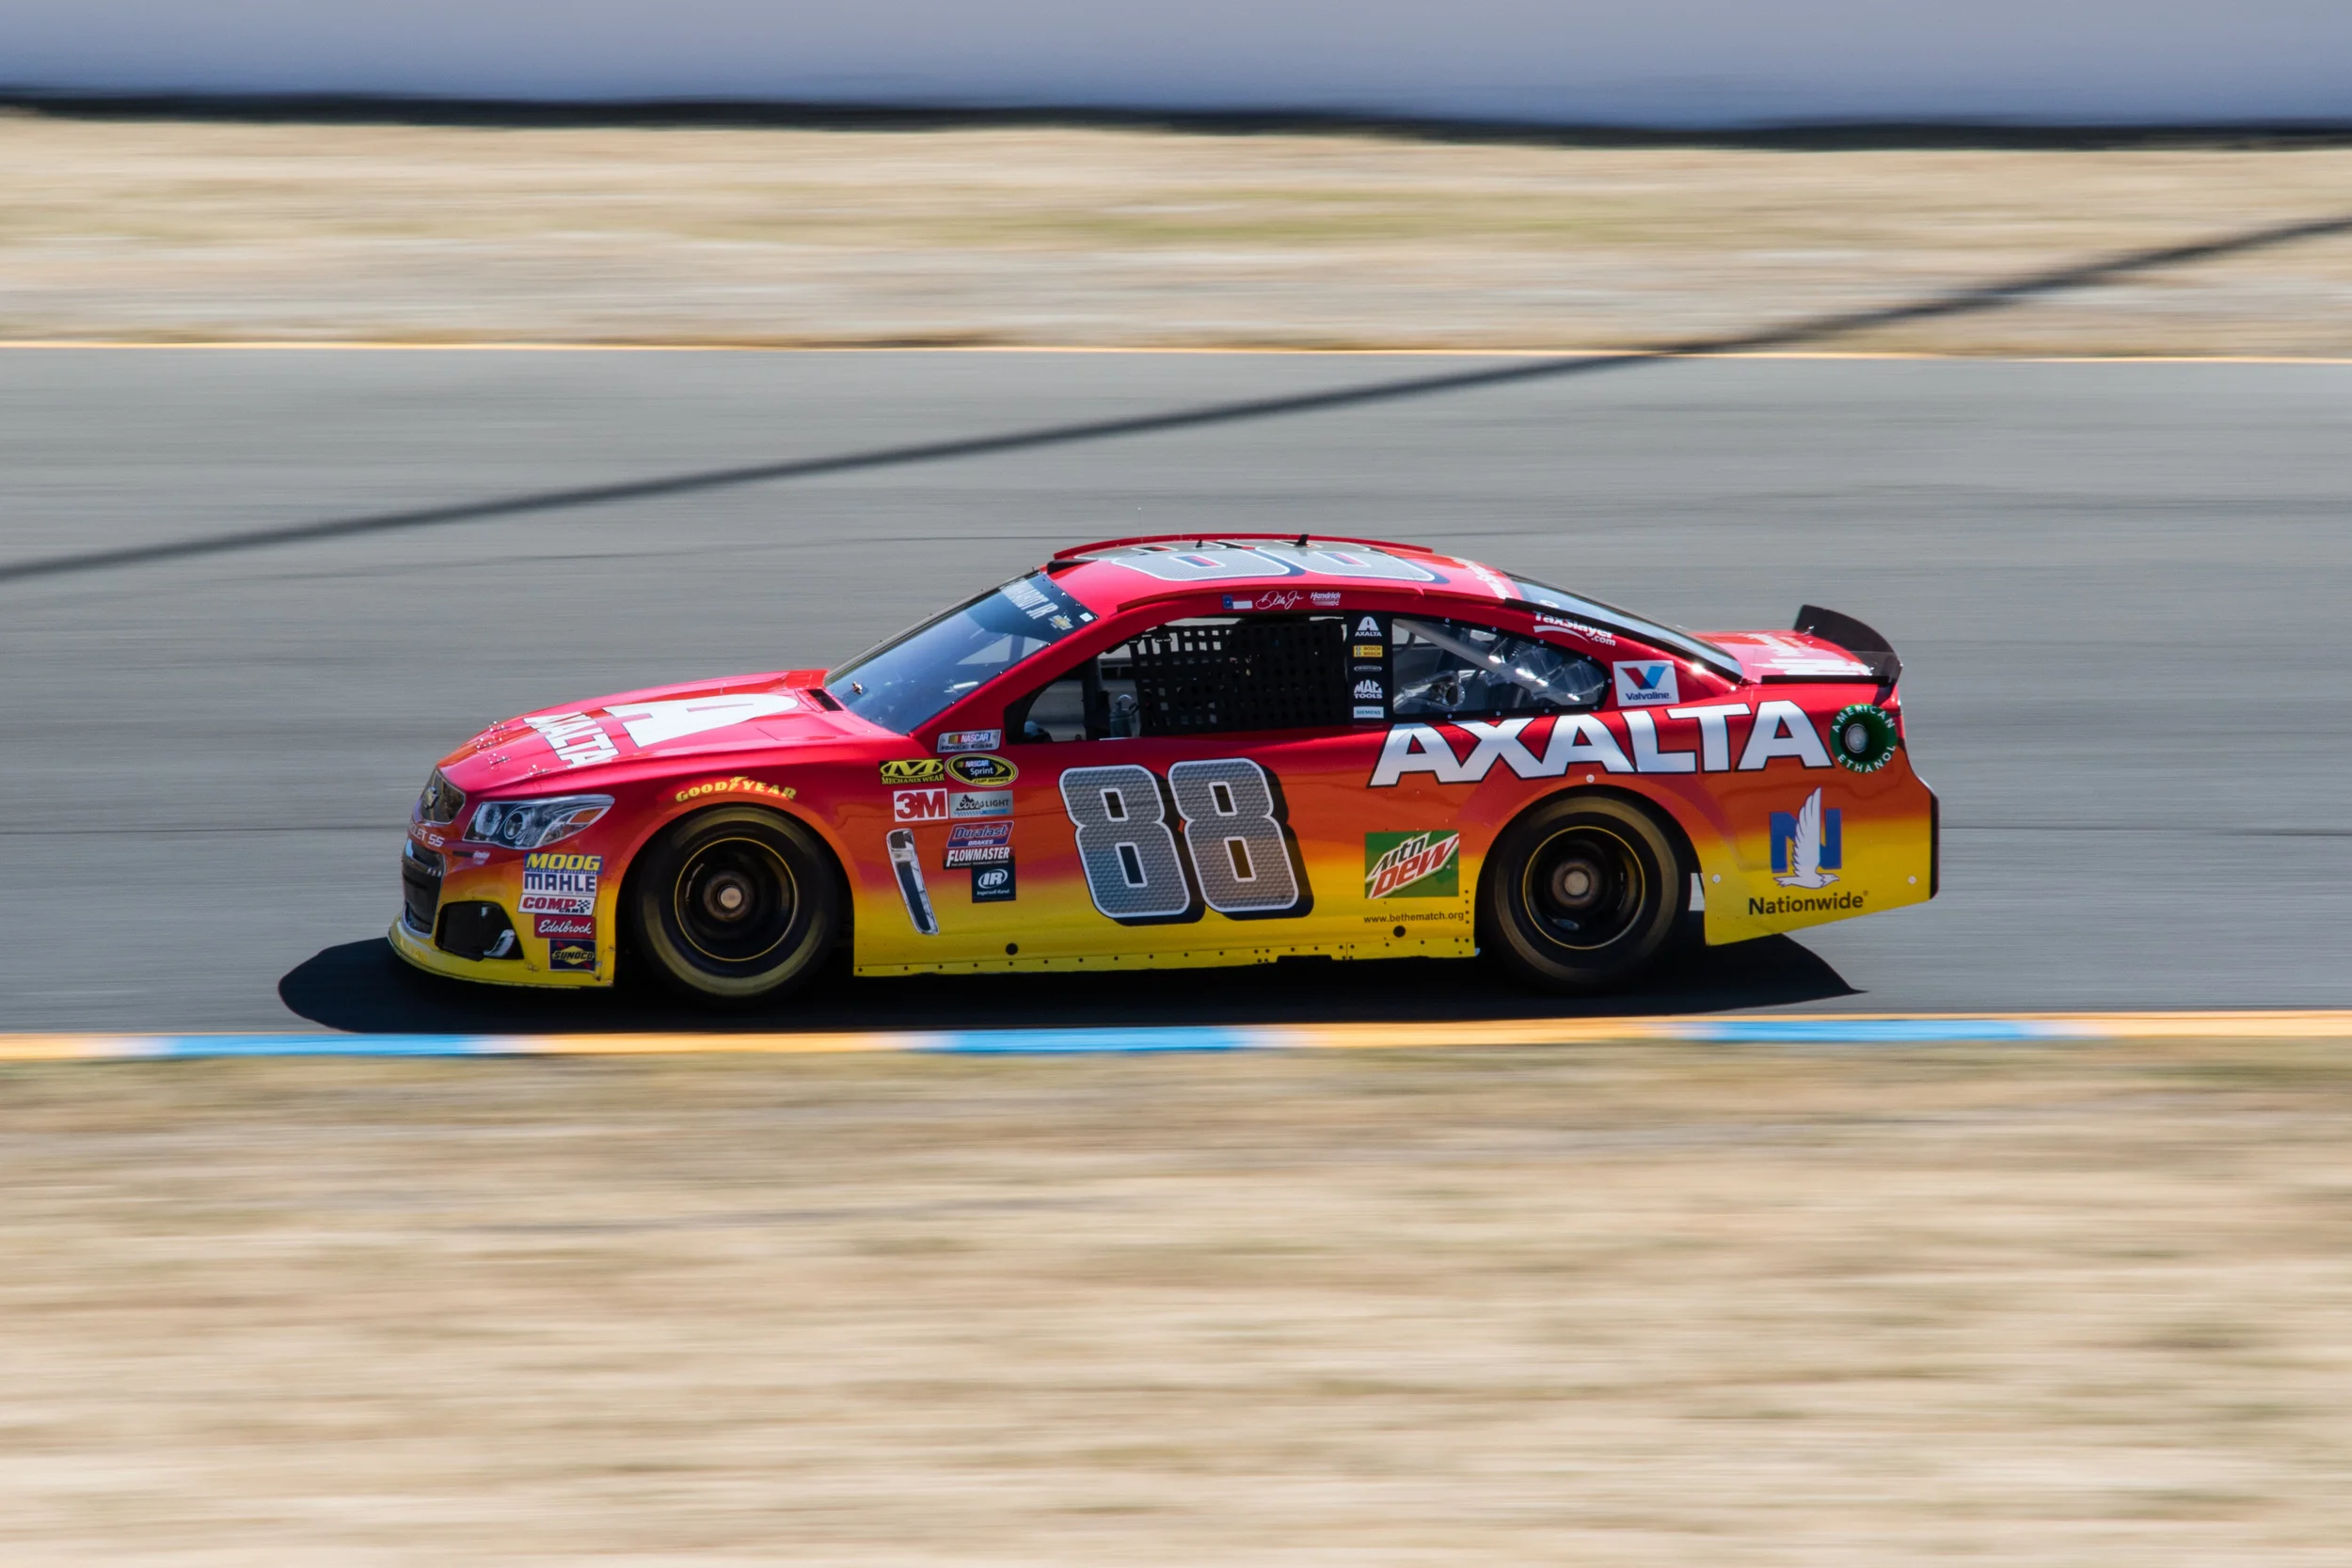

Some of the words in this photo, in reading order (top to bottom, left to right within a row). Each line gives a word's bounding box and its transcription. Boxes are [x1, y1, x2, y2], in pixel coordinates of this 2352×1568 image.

[1310, 592, 1341, 601] Hendrick
[1025, 602, 1058, 620] JR
[1533, 611, 1613, 639] TaxSlayer
[1591, 636, 1616, 646] .com
[1354, 679, 1383, 694] MAC
[1626, 691, 1670, 701] Valvoline
[1832, 705, 1895, 733] AMERICAN
[961, 733, 990, 743] NASCAR
[1369, 700, 1835, 788] AXALTA
[965, 759, 990, 768] NASCAR
[1837, 745, 1896, 773] ETHANOL
[882, 773, 922, 784] MECHANIX
[922, 773, 945, 784] WEAR
[970, 768, 993, 777] Sprint
[675, 776, 797, 802] GOODYEAR
[896, 790, 946, 819] 3M
[959, 798, 984, 809] Coors
[985, 800, 1009, 808] LIGHT
[953, 824, 1008, 840] Duralast
[1058, 757, 1300, 919] 88
[427, 833, 445, 847] SS
[526, 853, 601, 871] MOOG
[946, 847, 1010, 867] FLOWMASTER
[1371, 836, 1427, 879] Mtn
[524, 873, 596, 892] MAHLE
[982, 872, 1003, 886] IR
[522, 896, 577, 910] COMP
[1749, 892, 1864, 915] Nationwide
[1363, 911, 1465, 923] www.bethematch.org
[538, 919, 592, 934] Edelbrock
[553, 950, 595, 959] SUNOCO
